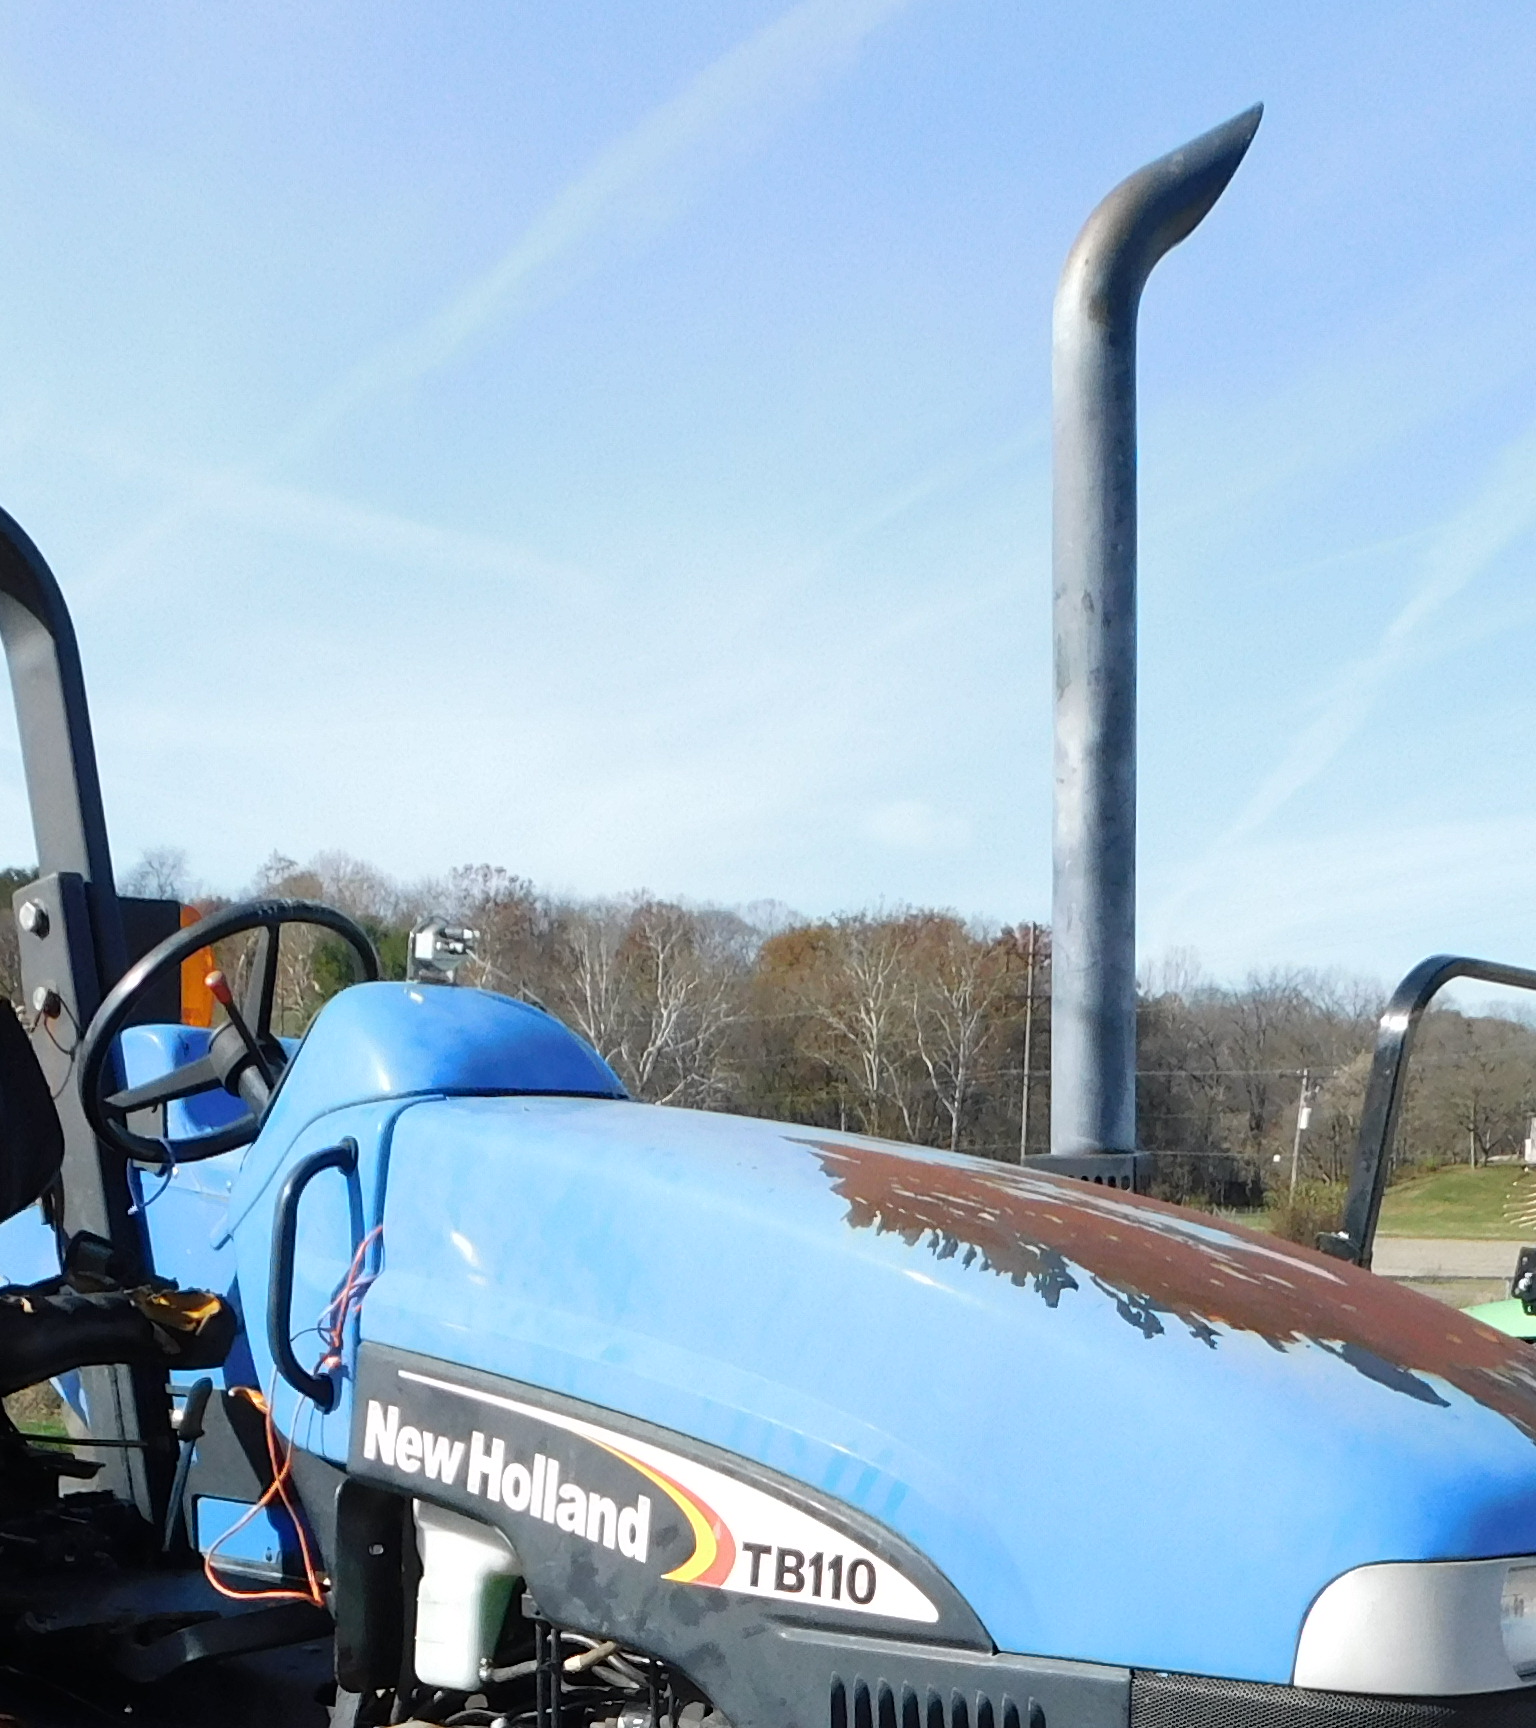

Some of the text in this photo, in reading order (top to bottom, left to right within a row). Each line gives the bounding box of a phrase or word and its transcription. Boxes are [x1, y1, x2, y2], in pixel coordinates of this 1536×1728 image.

[363, 1399, 651, 1564] New Holland
[742, 1541, 877, 1605] TB110
